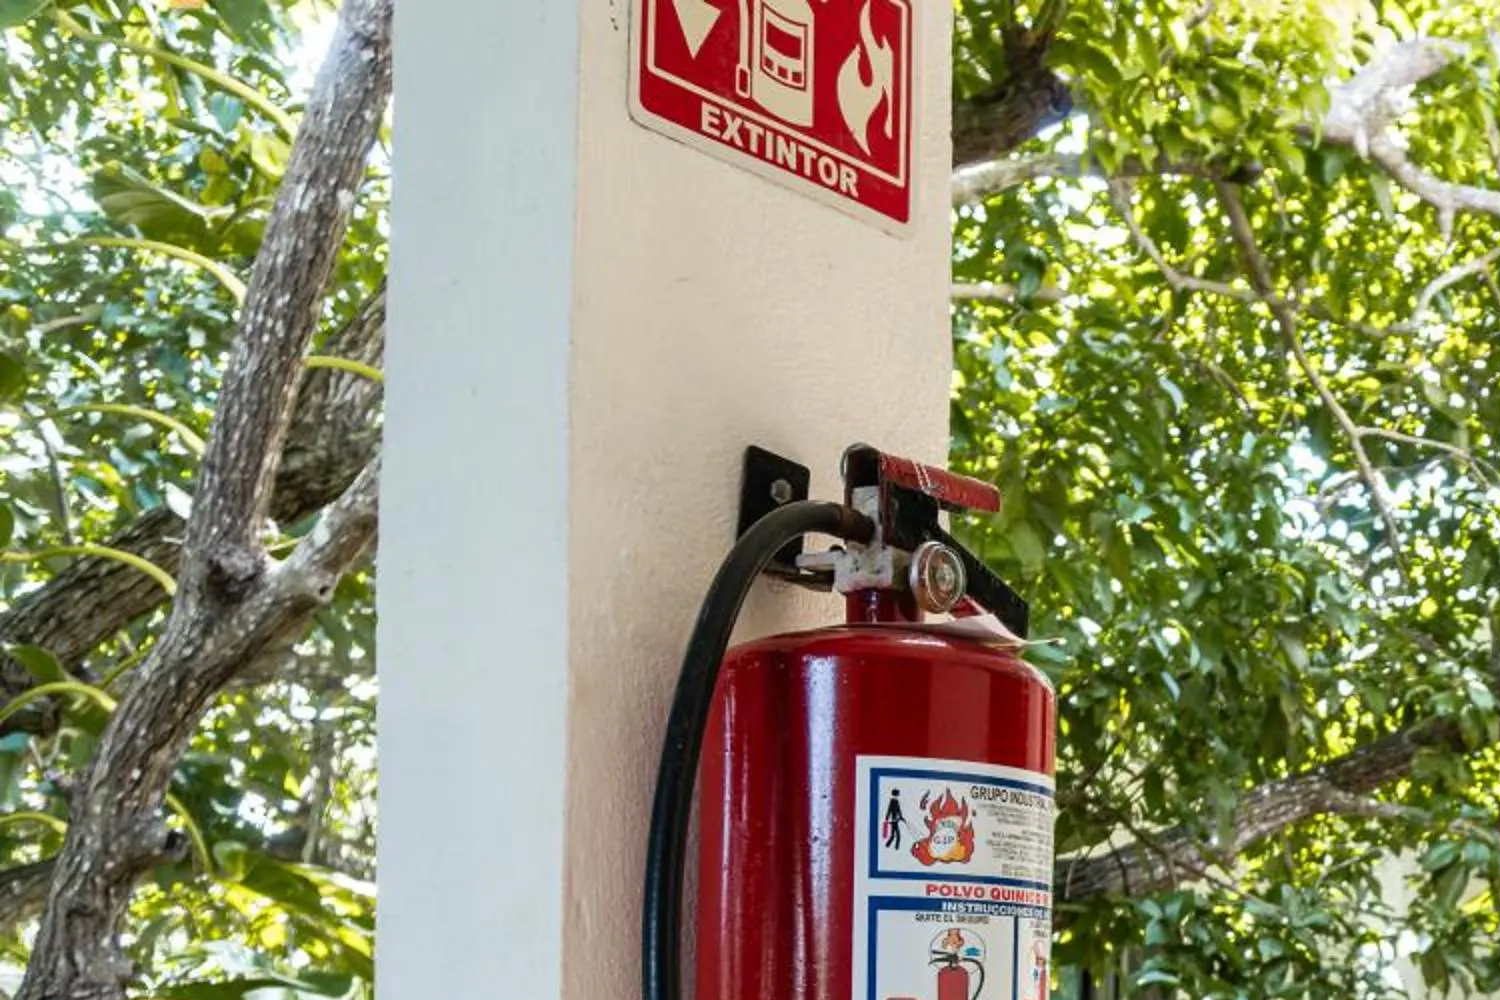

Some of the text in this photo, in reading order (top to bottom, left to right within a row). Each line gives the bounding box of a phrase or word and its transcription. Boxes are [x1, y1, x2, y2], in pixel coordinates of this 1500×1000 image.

[701, 100, 859, 198] EXTINTOR
[970, 785, 1008, 803] GRUPO
[926, 884, 985, 899] POLVO
